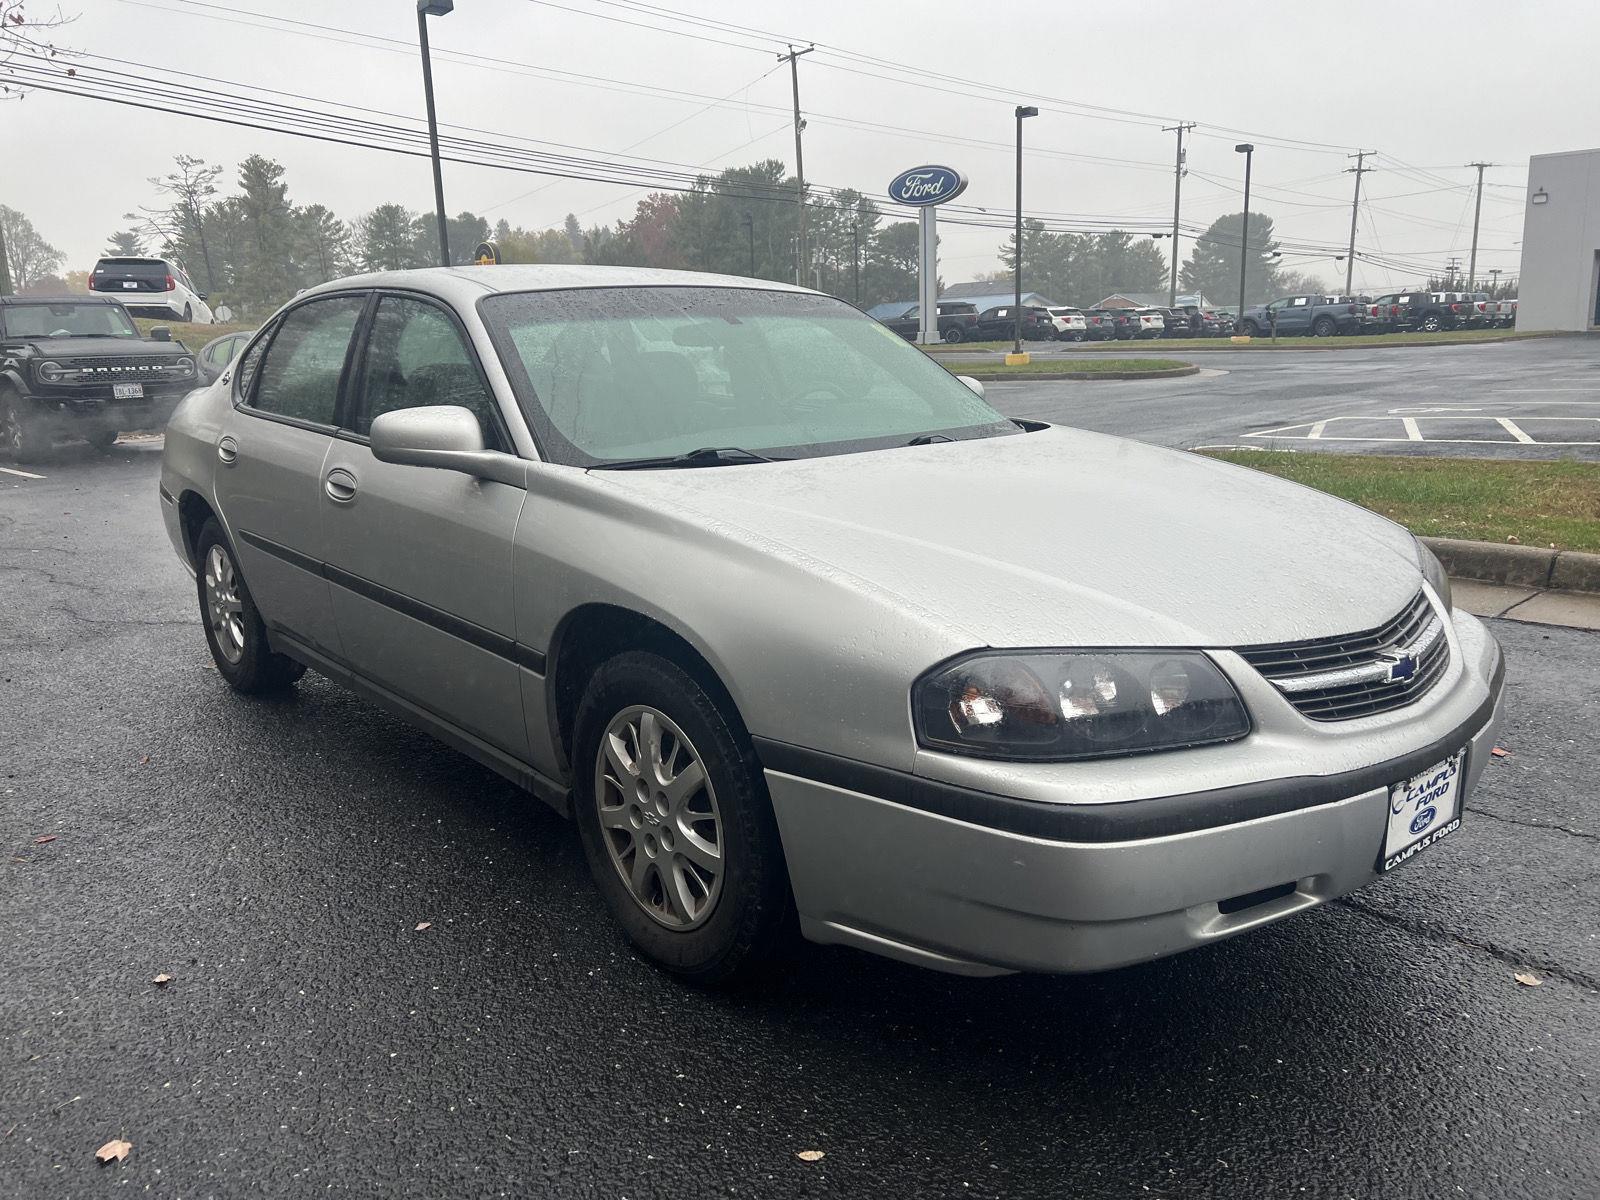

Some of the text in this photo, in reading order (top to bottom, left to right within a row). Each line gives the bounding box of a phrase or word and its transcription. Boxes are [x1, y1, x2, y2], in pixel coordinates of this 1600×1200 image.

[901, 172, 944, 199] Ford
[82, 365, 162, 373] BRONCO
[1414, 781, 1450, 811] FORD
[1384, 818, 1461, 871] CAMPUS FORD
